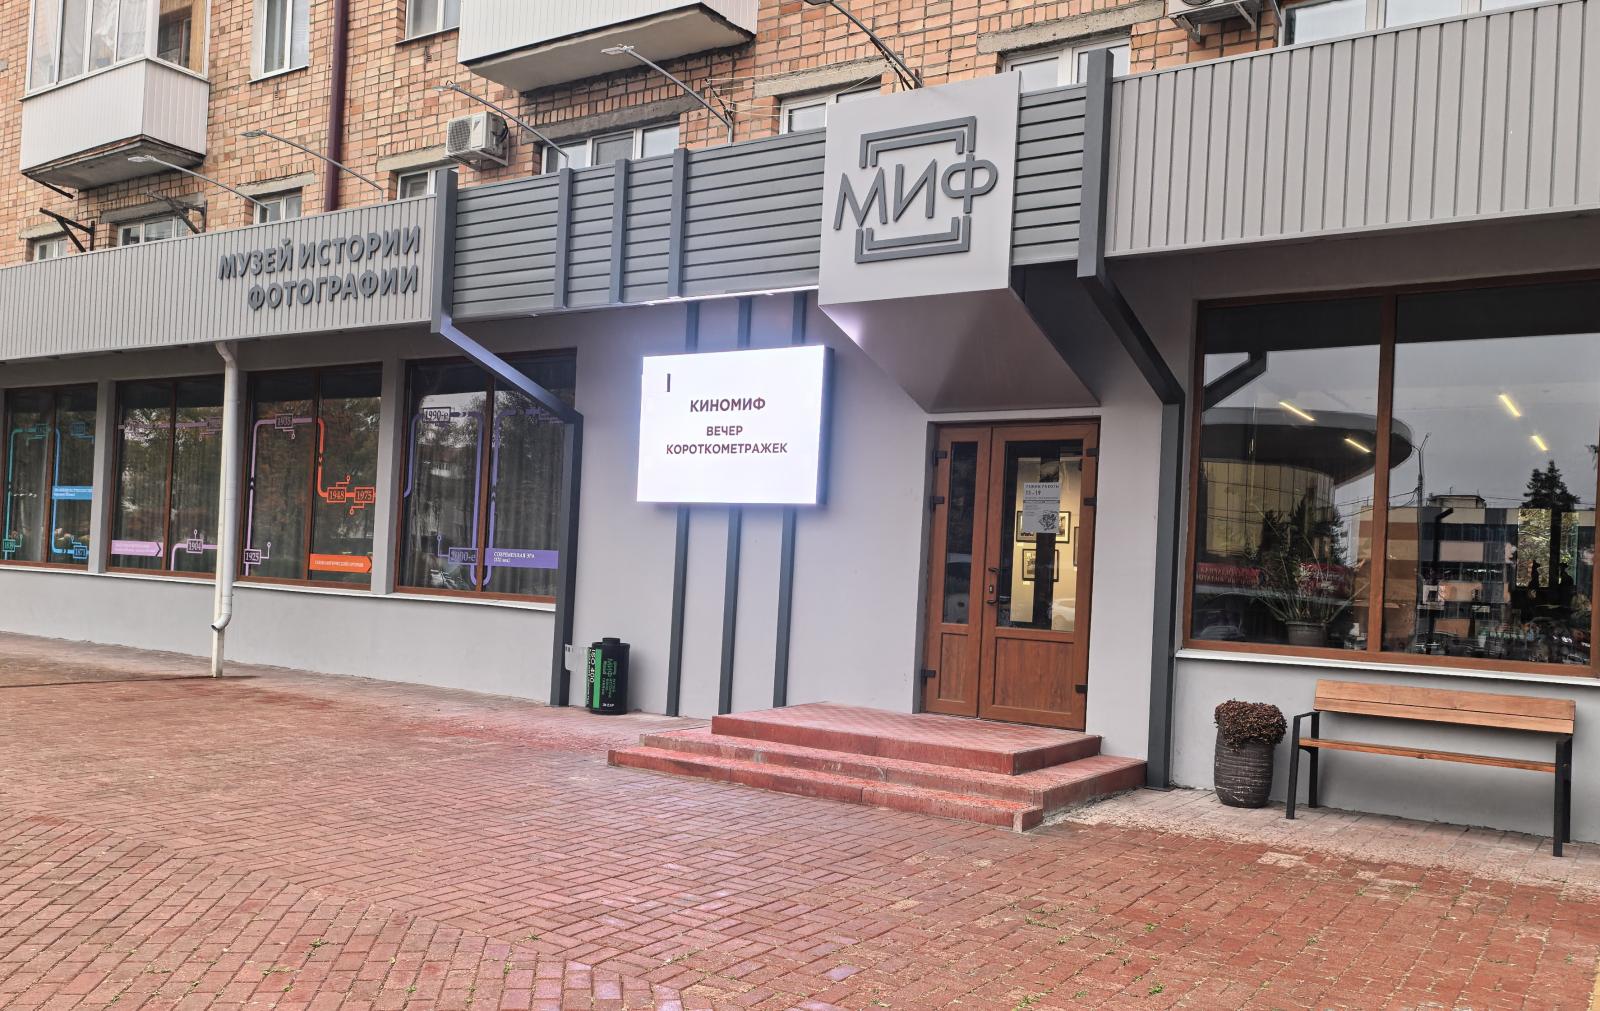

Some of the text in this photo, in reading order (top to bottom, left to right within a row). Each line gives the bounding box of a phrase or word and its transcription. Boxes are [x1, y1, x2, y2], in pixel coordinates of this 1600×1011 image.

[833, 153, 998, 230] МИФ
[218, 225, 420, 280] МУЗЕЙ ИСТОРИИ
[248, 265, 418, 310] ФОТОГРАФИИ
[689, 397, 766, 413] КИНОМИФ
[706, 425, 743, 436] ВЕЧЕР
[666, 442, 788, 455] КОРОТКОМЕТРАЖЕК
